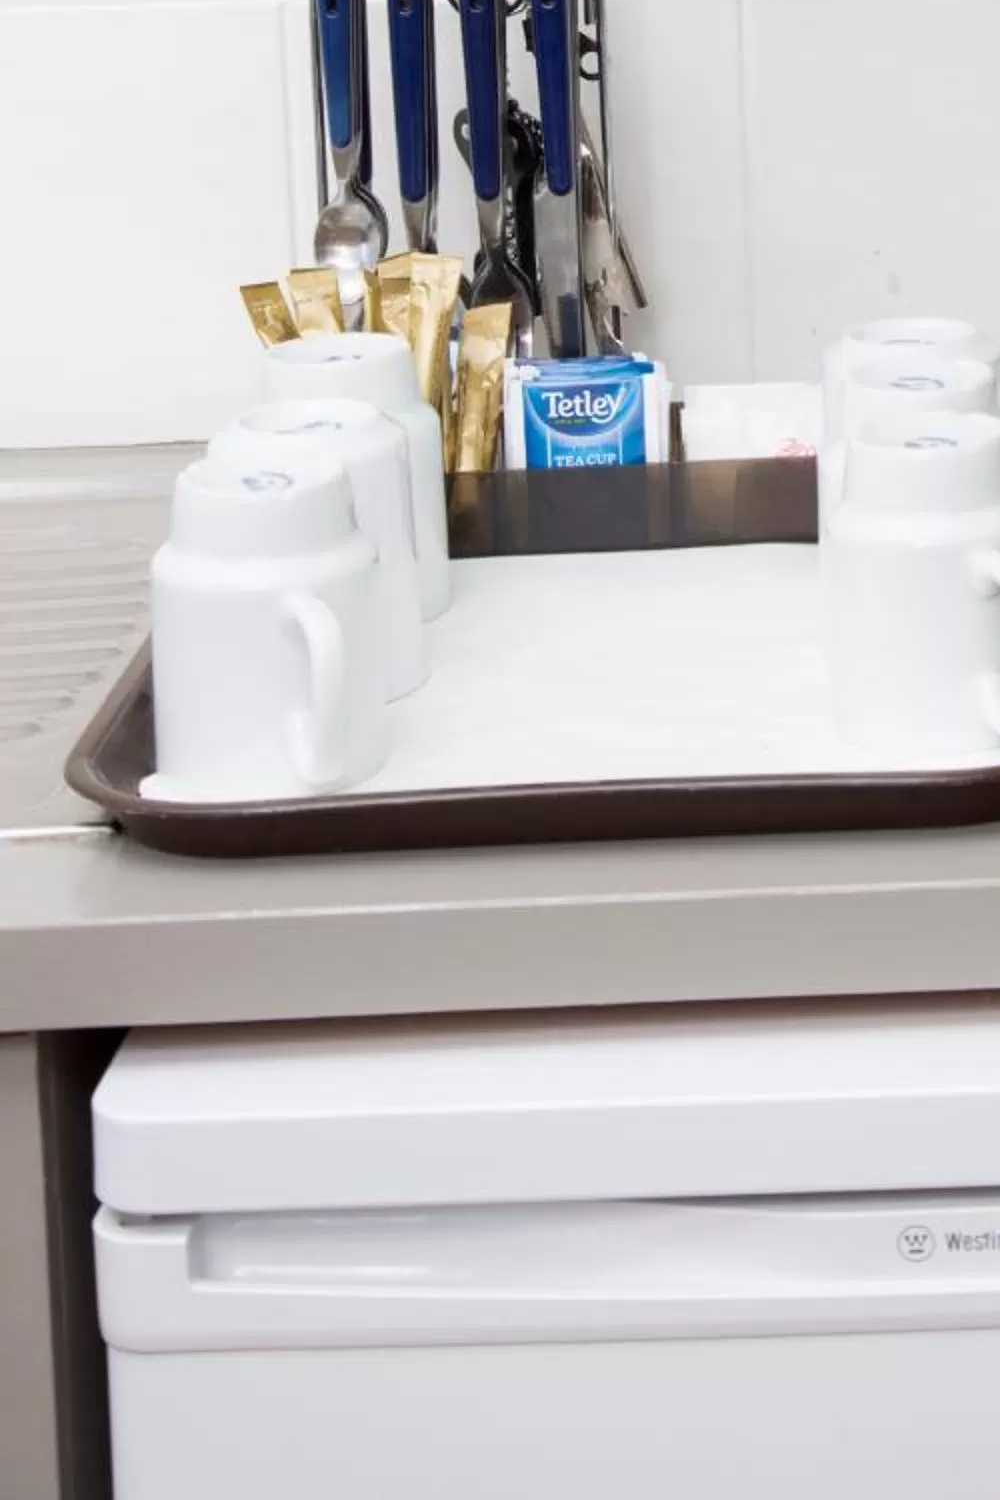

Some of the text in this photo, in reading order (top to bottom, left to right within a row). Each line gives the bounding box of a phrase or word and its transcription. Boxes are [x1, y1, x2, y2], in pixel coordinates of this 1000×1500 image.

[541, 386, 627, 424] Tetley
[554, 453, 617, 467] TEA CUP
